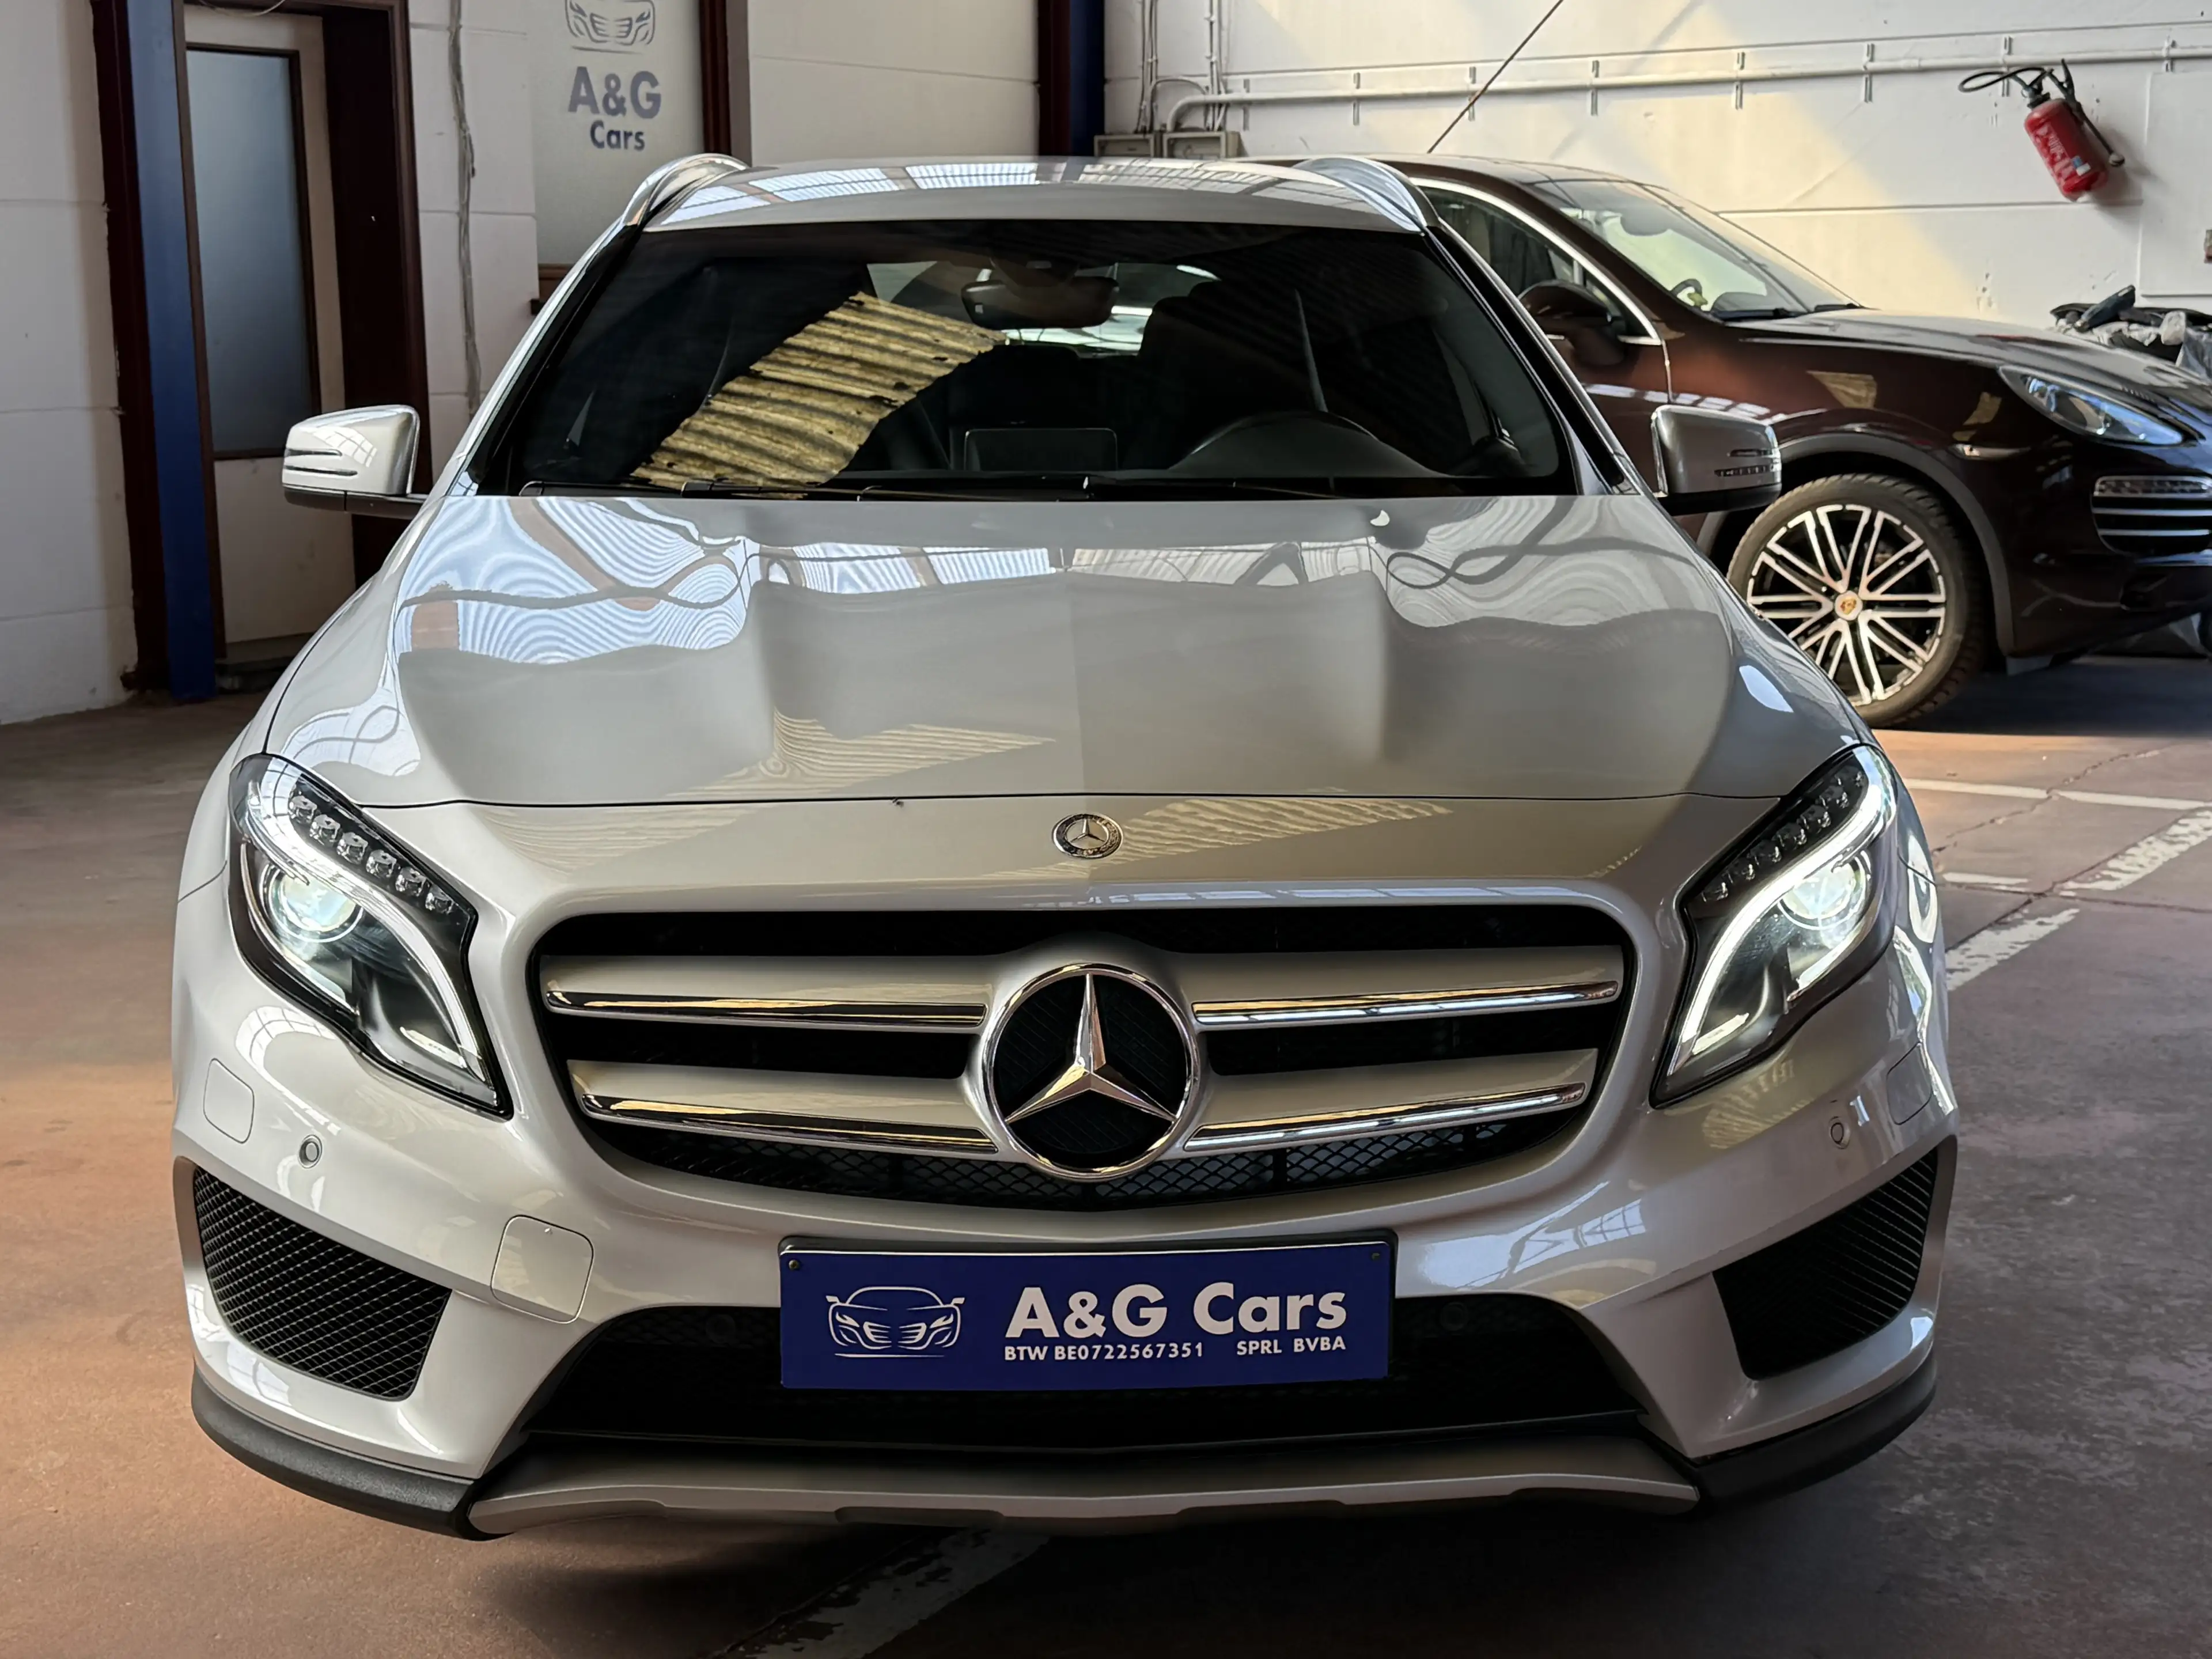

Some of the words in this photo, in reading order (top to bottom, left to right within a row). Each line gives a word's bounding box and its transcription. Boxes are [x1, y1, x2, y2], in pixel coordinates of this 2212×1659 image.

[567, 66, 661, 119] A&G
[589, 119, 645, 151] Cars
[1005, 1284, 1168, 1339] A&G
[1193, 1282, 1347, 1335] Cars
[1005, 1345, 1048, 1361] BTW
[1054, 1342, 1203, 1360] BE0722567351
[1237, 1339, 1282, 1355] SPRL
[1294, 1336, 1347, 1353] BVBA
